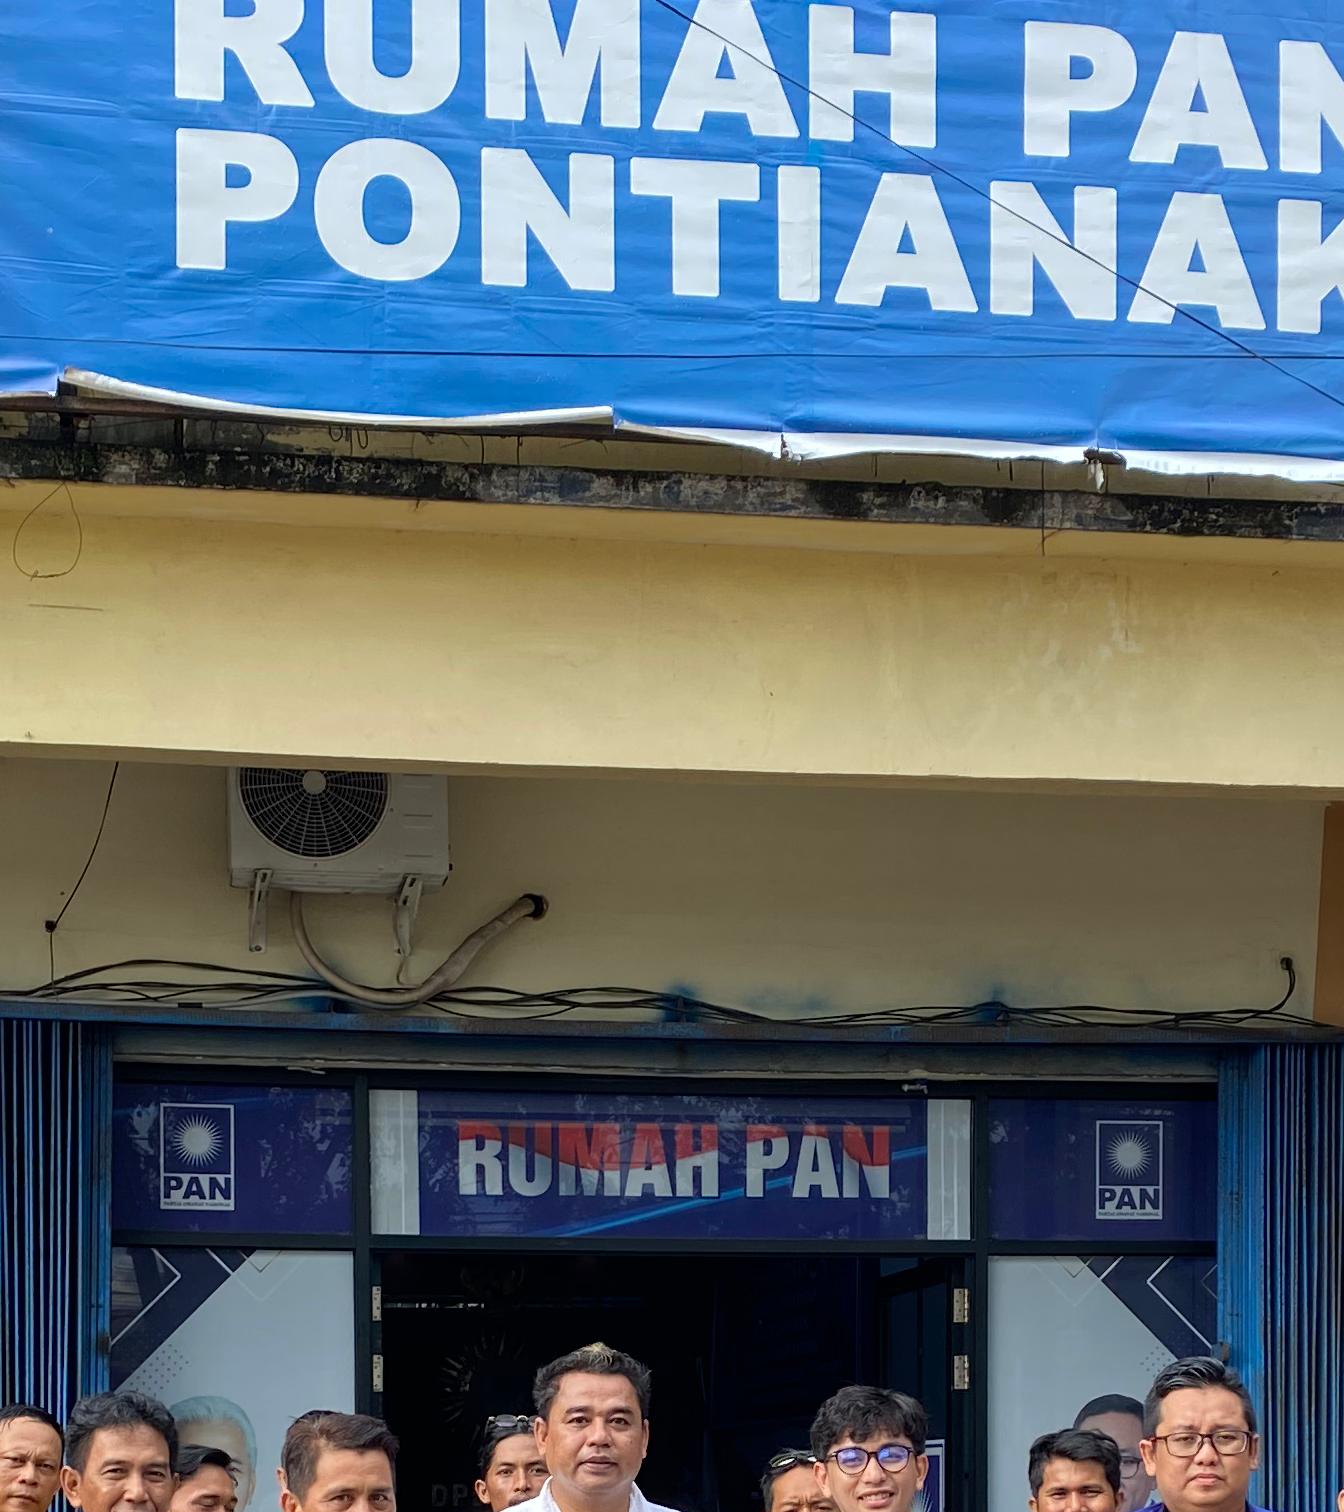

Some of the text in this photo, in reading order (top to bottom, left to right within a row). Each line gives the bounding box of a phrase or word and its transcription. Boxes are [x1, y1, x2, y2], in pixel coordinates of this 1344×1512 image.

[174, 0, 937, 148] RUMAH
[458, 1120, 890, 1199] RUMAH PAN
[163, 1175, 232, 1201] PAN
[1098, 1187, 1161, 1210] PAN
